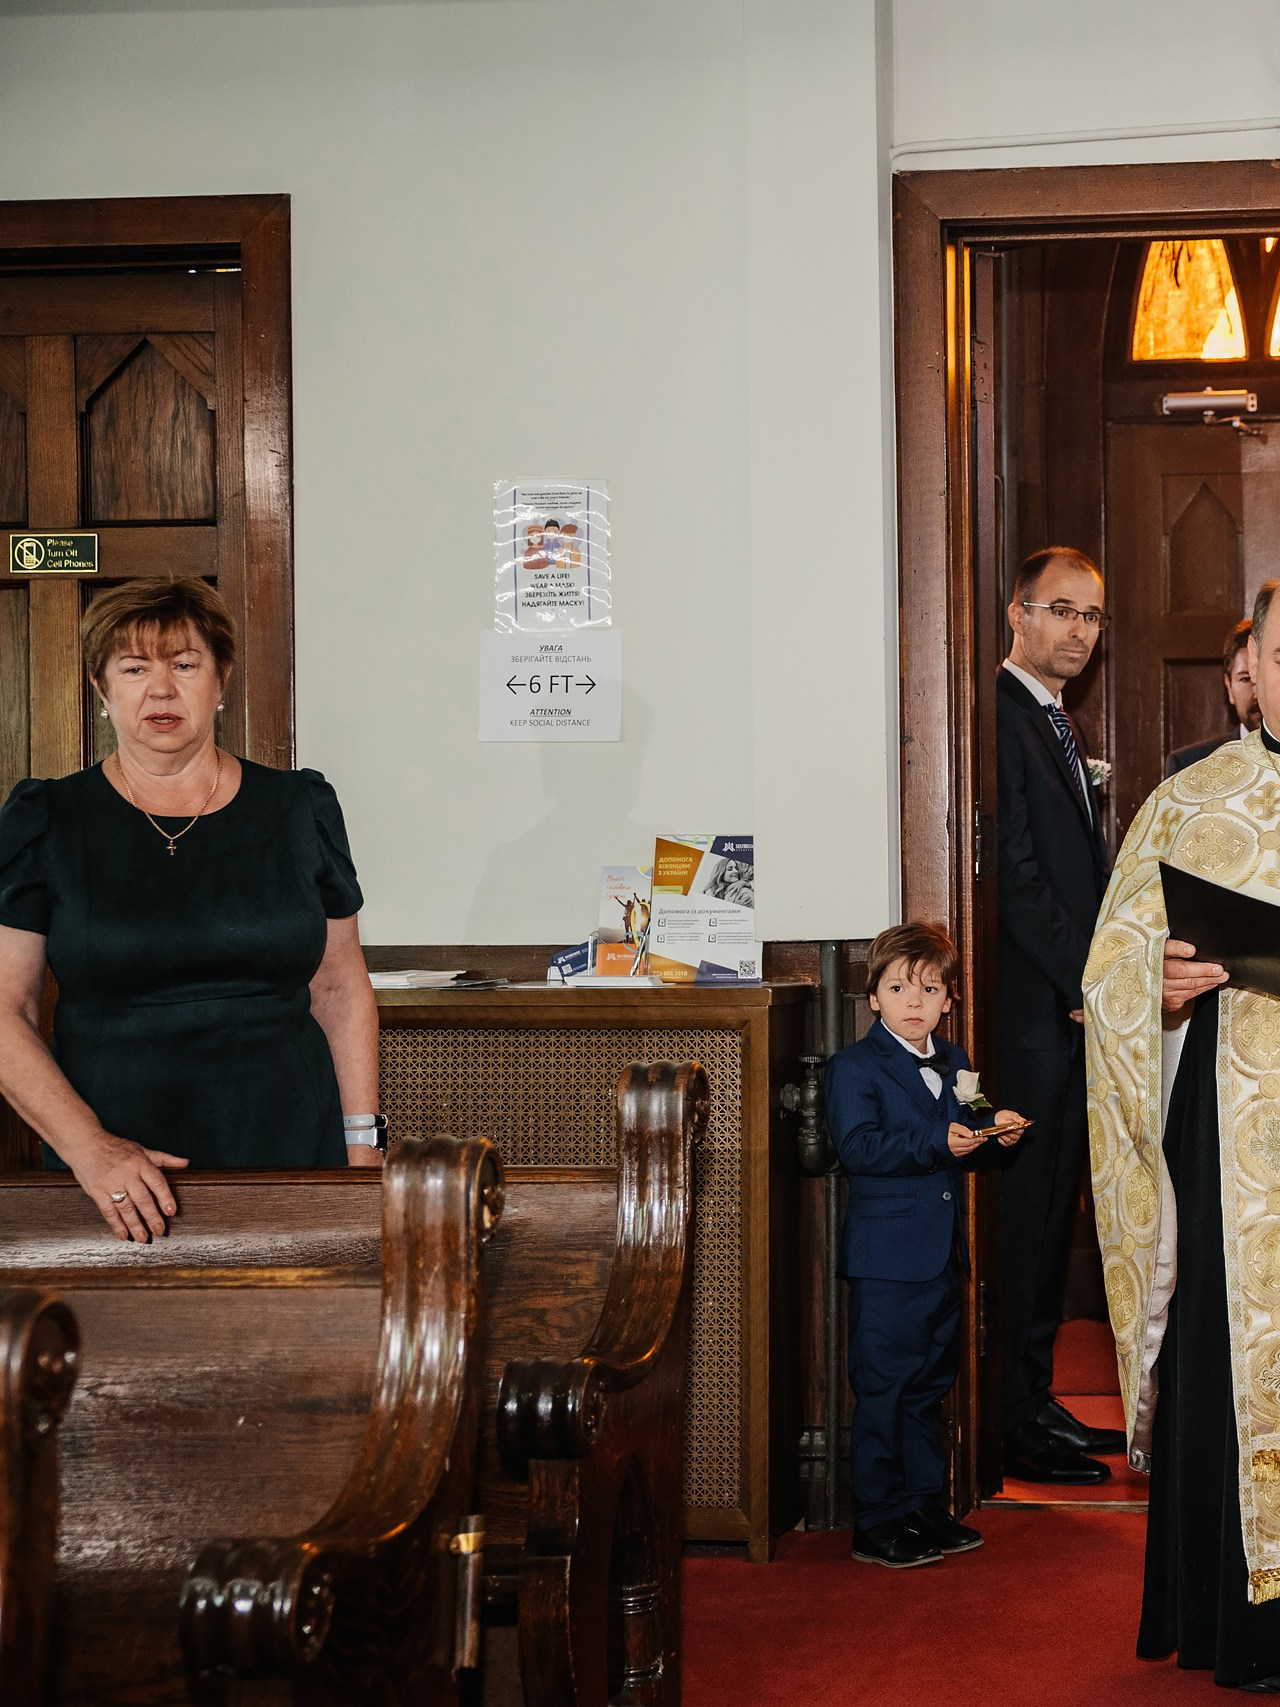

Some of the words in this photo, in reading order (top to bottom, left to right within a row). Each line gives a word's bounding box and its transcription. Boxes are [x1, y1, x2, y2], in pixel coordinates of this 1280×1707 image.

[46, 539, 73, 547] Please
[47, 549, 64, 557] Turn
[65, 549, 78, 557] Off
[47, 560, 62, 568] Cell
[64, 560, 94, 568] Phones
[510, 655, 553, 663] ЗБЕРІГАЙТЕ
[529, 675, 541, 693] 6
[550, 675, 574, 693] FT
[530, 708, 572, 716] ATTENTION
